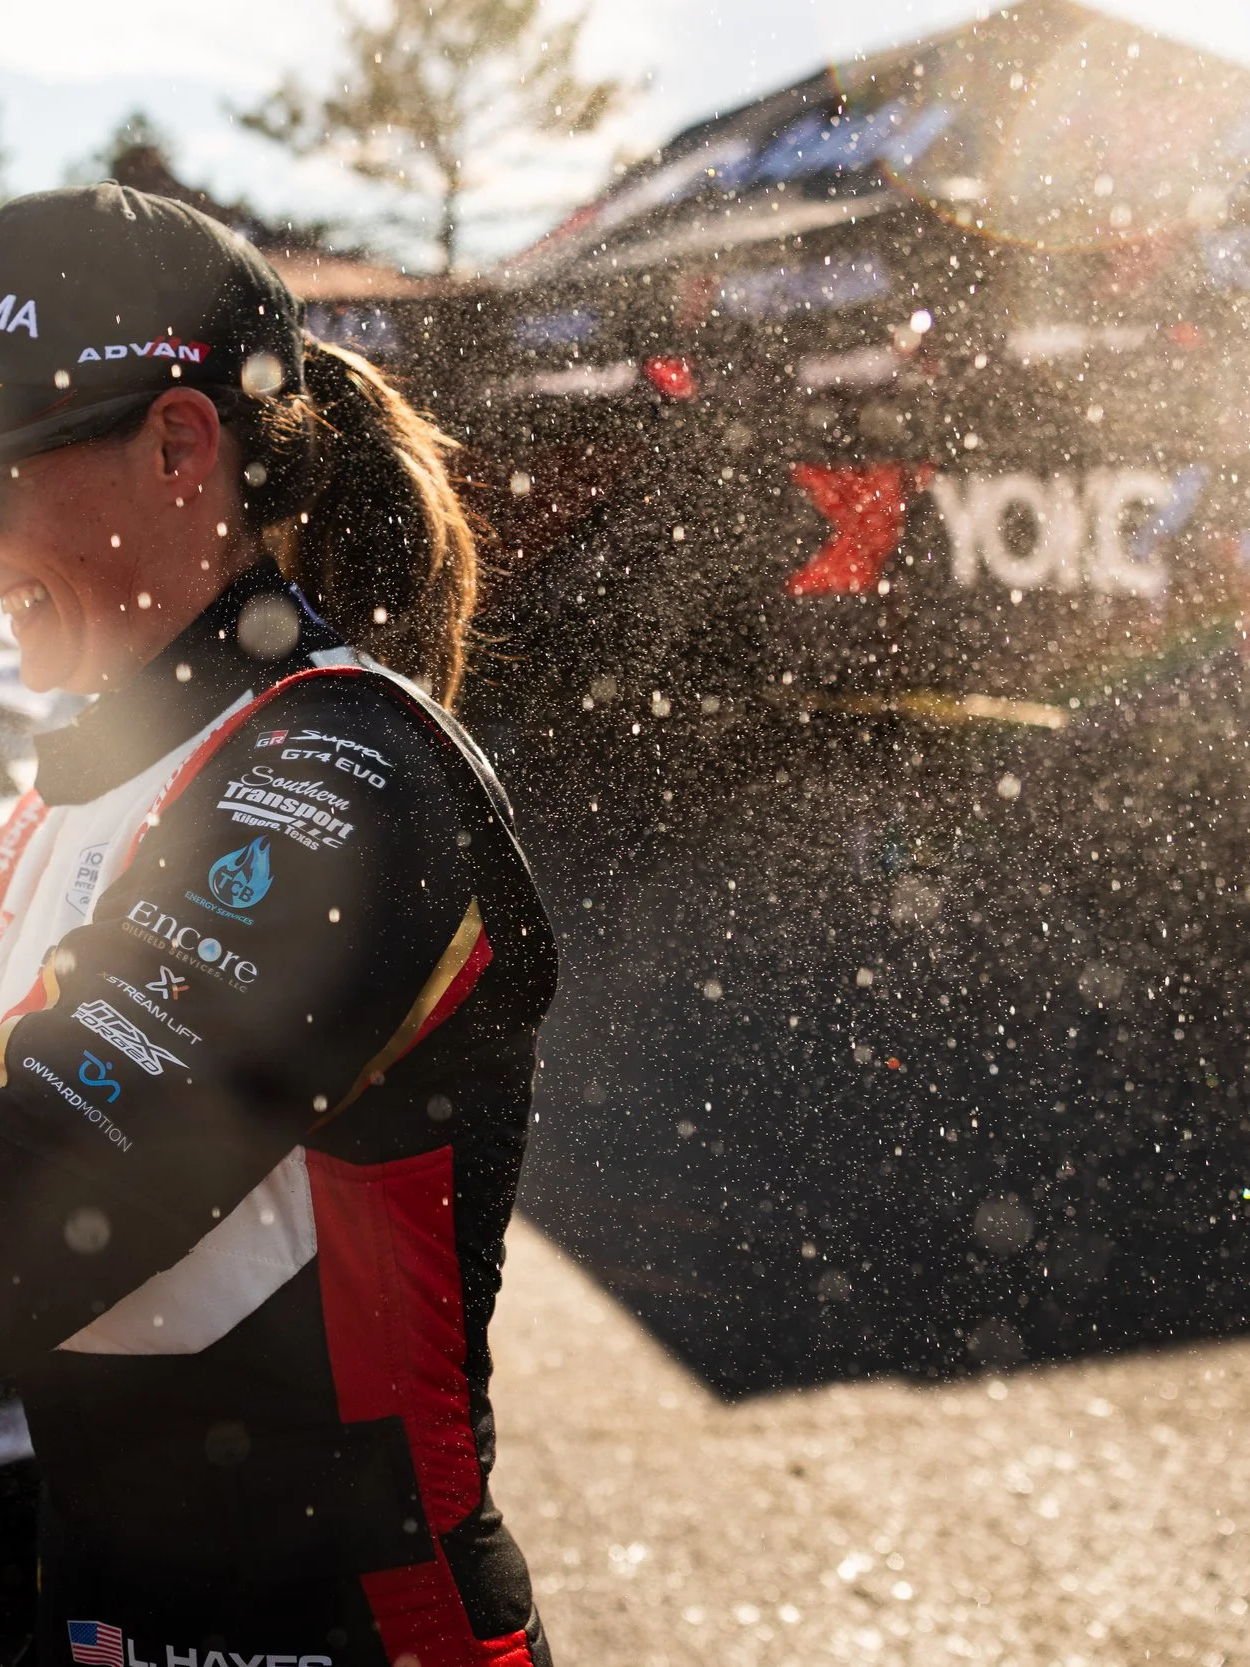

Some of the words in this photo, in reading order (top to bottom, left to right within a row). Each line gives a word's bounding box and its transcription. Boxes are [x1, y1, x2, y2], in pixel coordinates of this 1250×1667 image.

[78, 341, 201, 363] ADVAN
[280, 748, 332, 763] GT4
[334, 757, 386, 789] EVO
[290, 729, 394, 768] Supra
[241, 765, 351, 811] Southern
[224, 780, 354, 840] Transport
[231, 811, 281, 831] Kilgore,
[284, 825, 320, 851] Texas
[218, 871, 255, 903] TCB
[184, 890, 218, 911] ENERGY
[215, 908, 255, 926] SERVICES
[121, 921, 166, 950] OILFIELD
[228, 978, 248, 993] LLC
[126, 899, 258, 984] Encore
[70, 1008, 162, 1075] FORGED
[167, 1017, 203, 1045] LIFT
